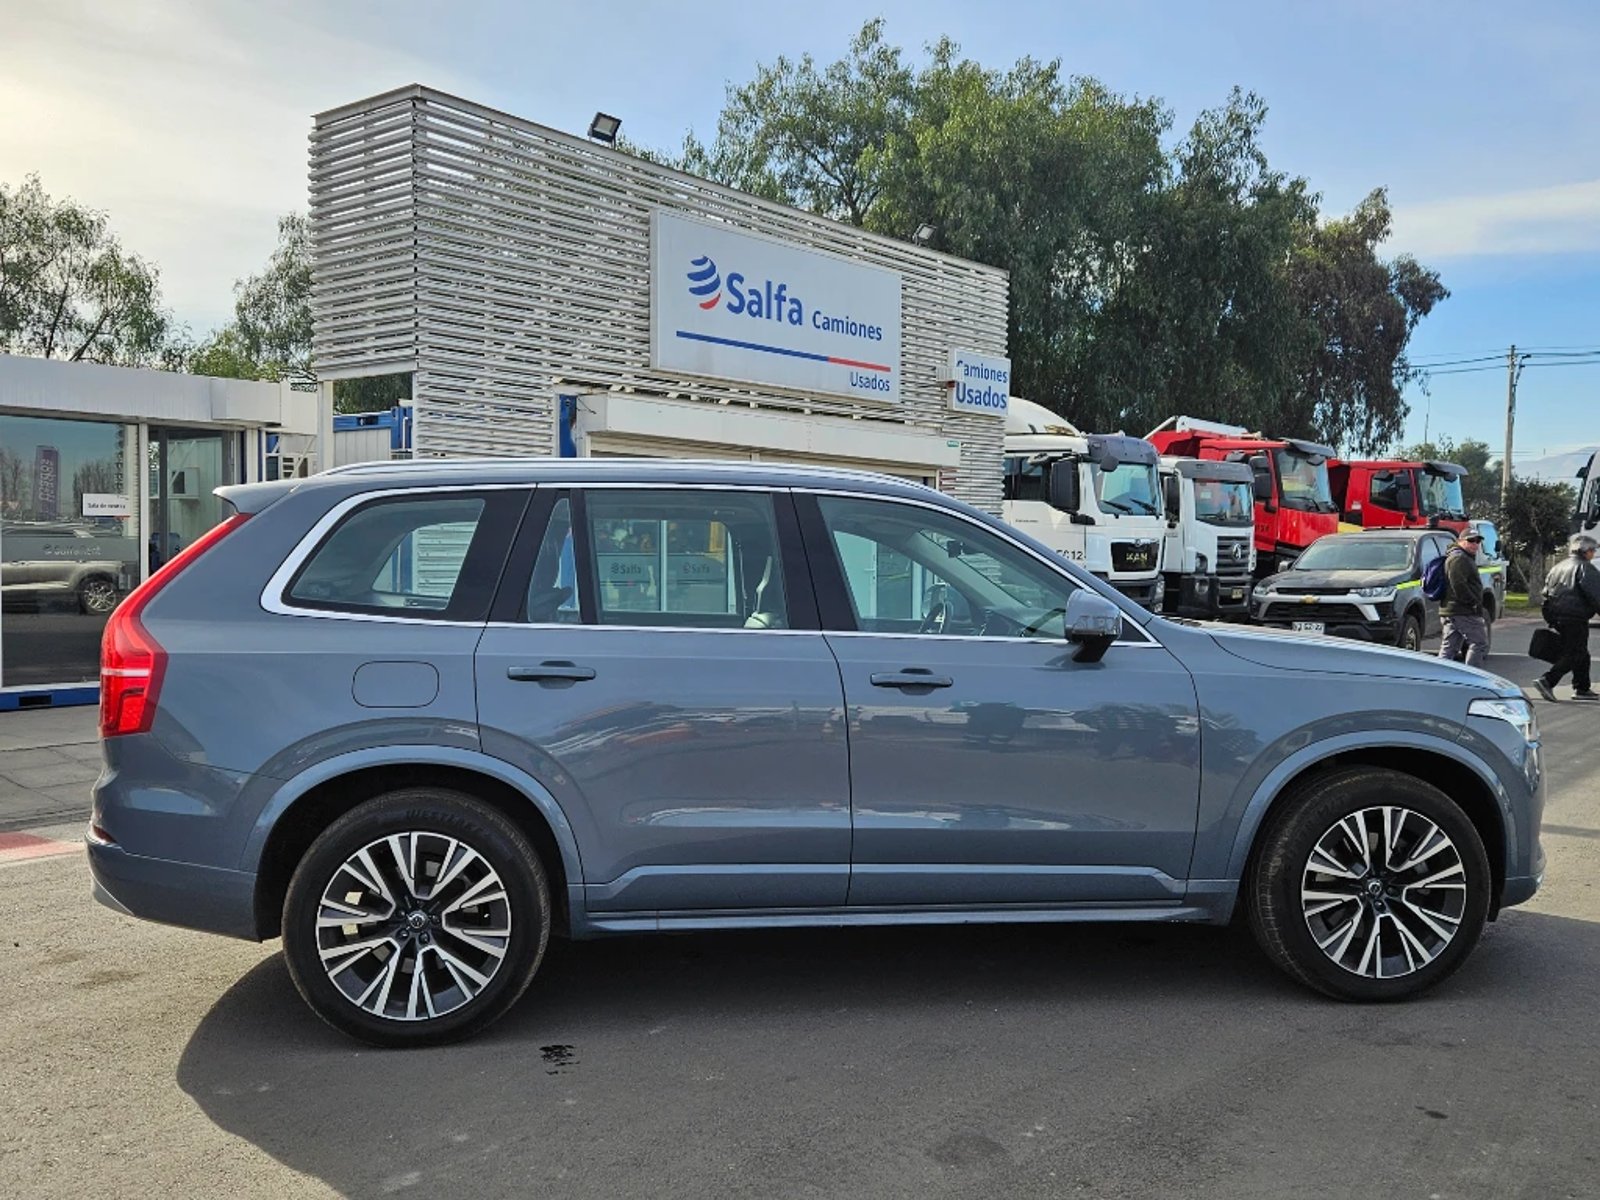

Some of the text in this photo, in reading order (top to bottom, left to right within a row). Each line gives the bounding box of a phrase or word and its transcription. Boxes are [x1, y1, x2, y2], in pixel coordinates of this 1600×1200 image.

[726, 272, 883, 341] Salfa Camiones
[850, 371, 890, 393] Usados
[956, 381, 1008, 409] Usados
